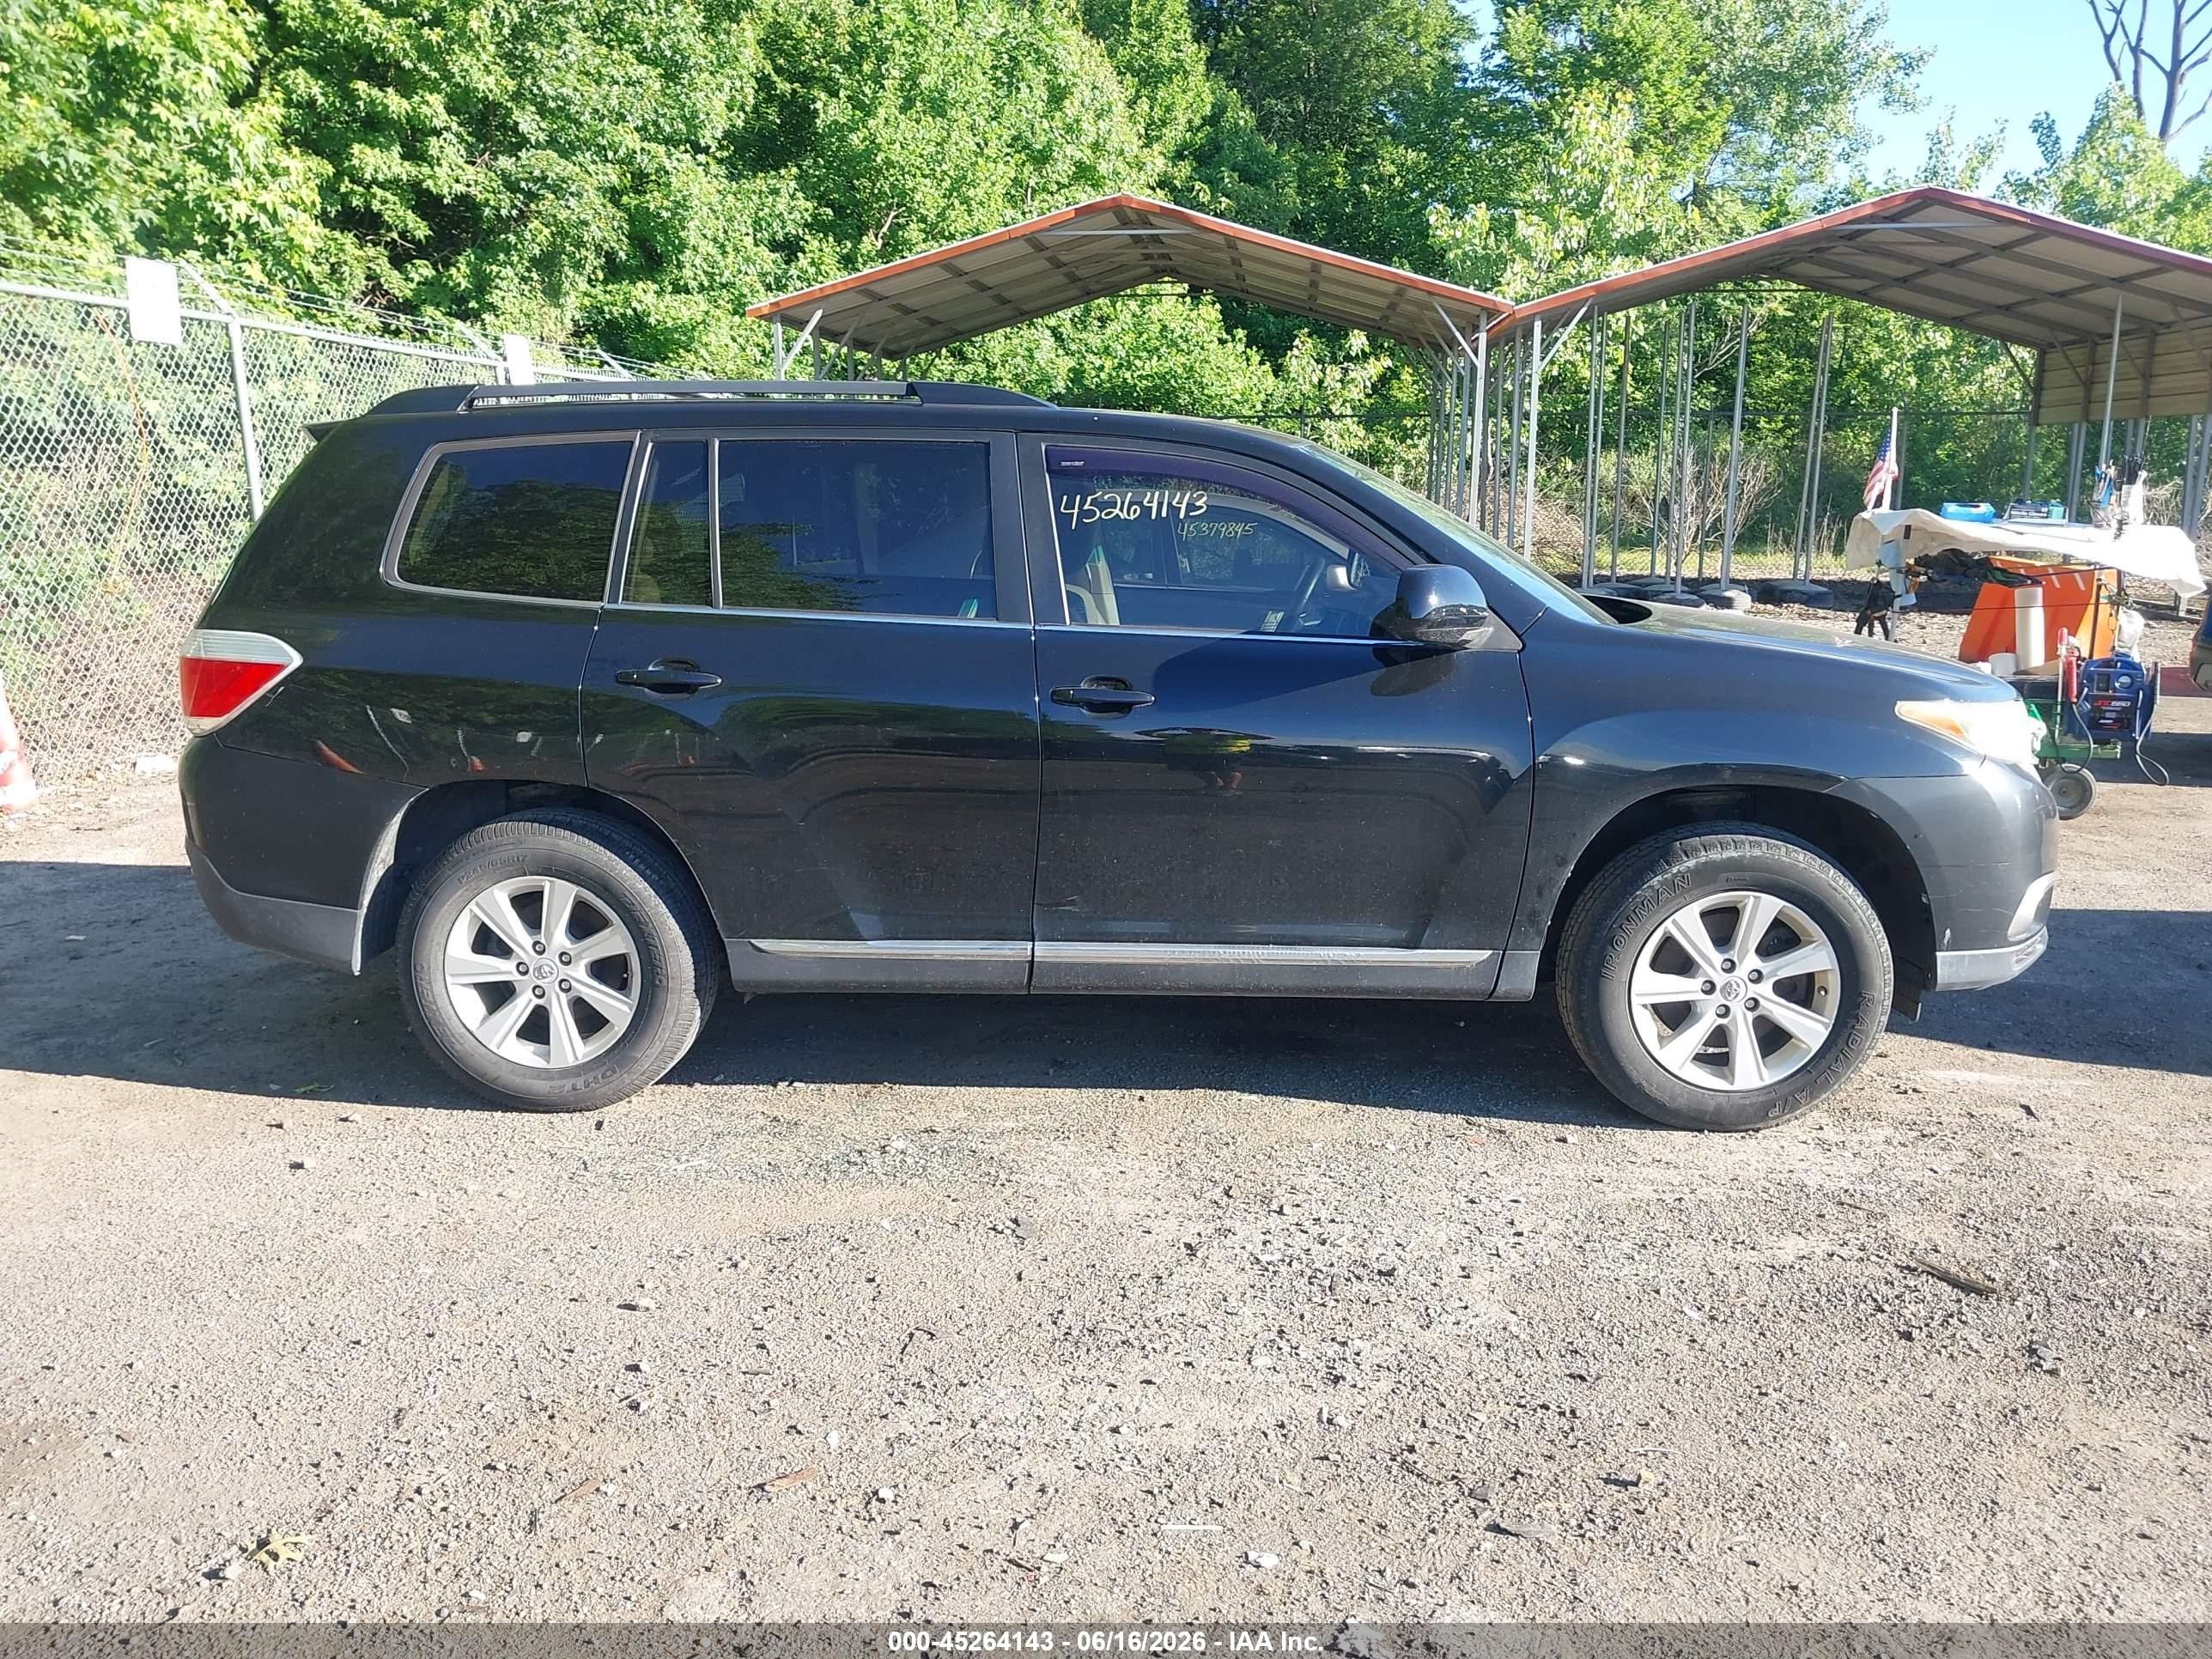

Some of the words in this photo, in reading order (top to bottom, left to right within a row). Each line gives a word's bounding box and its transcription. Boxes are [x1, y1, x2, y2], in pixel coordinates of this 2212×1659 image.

[1060, 490, 1208, 530] 45264143
[1177, 522, 1258, 541] 45379845
[1601, 872, 1692, 981] IRONMAN
[1814, 990, 1875, 1085] RADIAL
[1767, 1085, 1812, 1117] A/P
